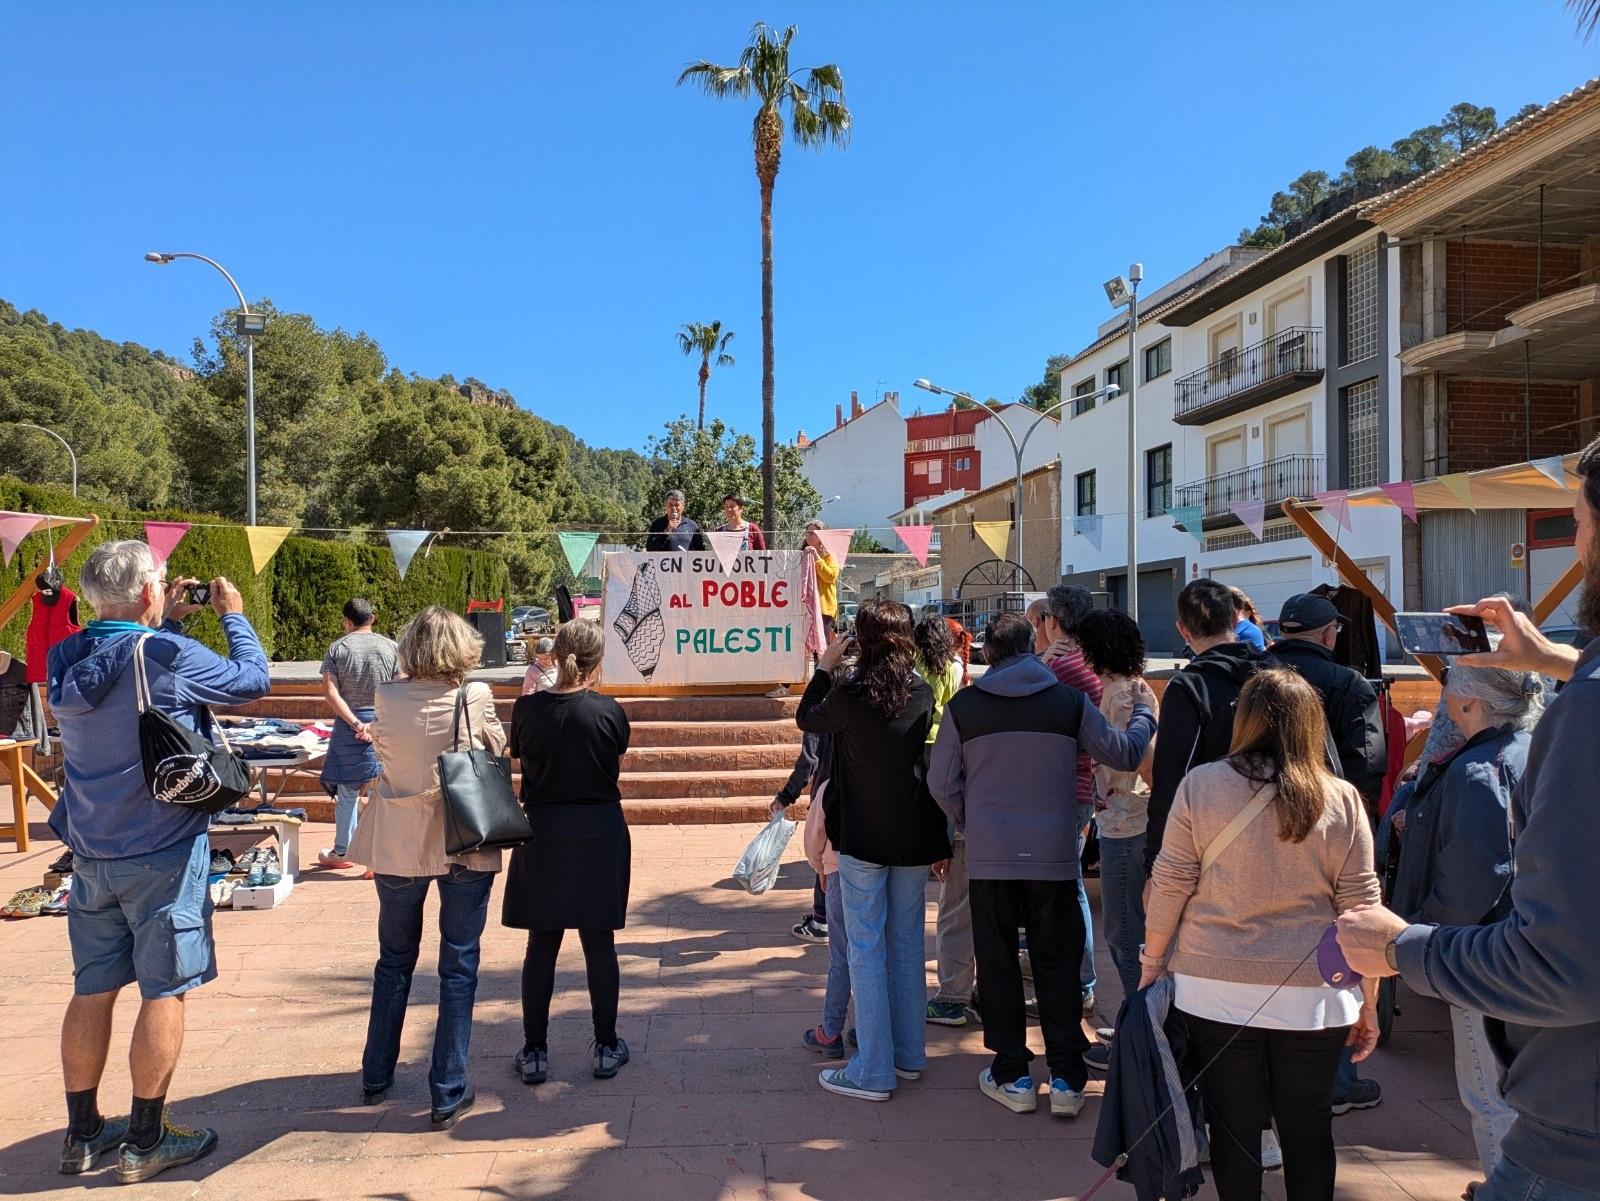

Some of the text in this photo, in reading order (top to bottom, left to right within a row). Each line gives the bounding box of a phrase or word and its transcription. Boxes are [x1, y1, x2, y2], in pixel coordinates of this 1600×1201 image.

[660, 556, 773, 574] EN SUORT
[670, 580, 789, 608] AL POBLE
[676, 623, 792, 654] PALESTÍ
